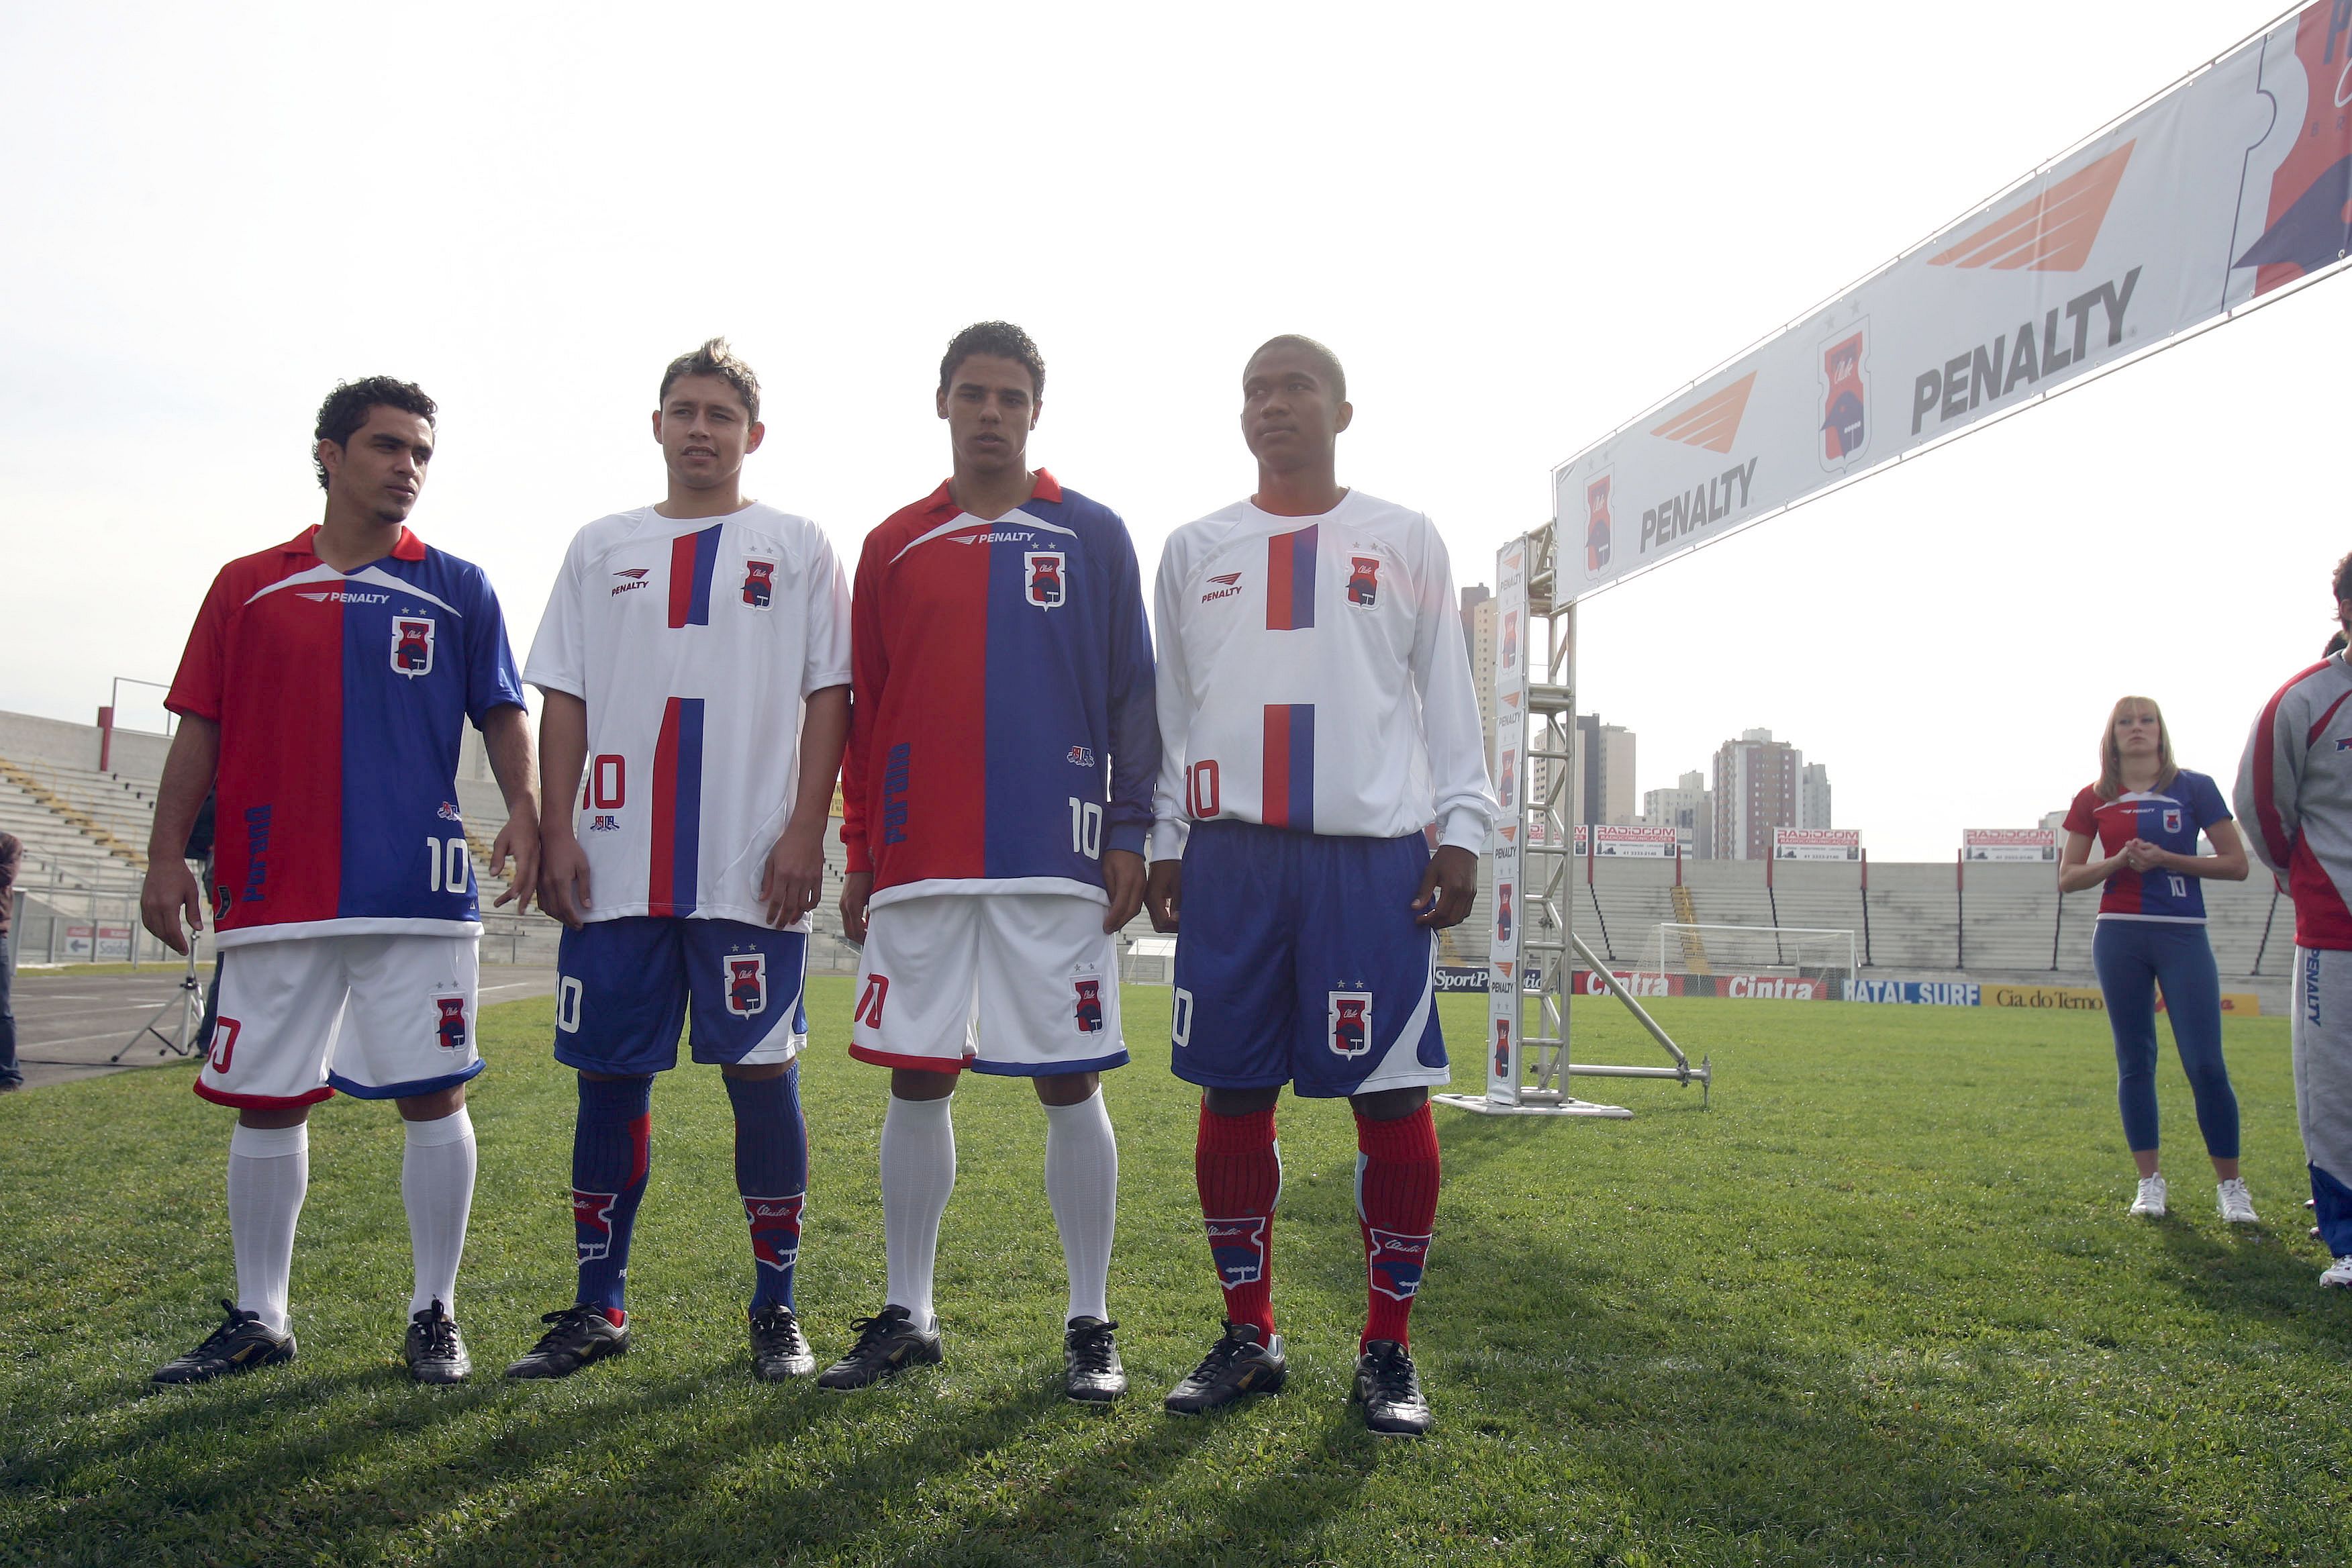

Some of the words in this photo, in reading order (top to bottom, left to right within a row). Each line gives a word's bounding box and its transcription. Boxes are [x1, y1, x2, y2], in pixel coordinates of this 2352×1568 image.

[1912, 265, 2143, 436] PENALTY
[1640, 456, 1758, 553] PENALTY
[978, 532, 1035, 544] PENALTY
[611, 581, 649, 597] PENALTY
[1500, 573, 1523, 593] PENALTY
[330, 591, 390, 603] PENALTY
[1202, 586, 1242, 604] PENALTY
[1499, 712, 1522, 727] PENALTY
[1069, 797, 1103, 860] 10
[1495, 846, 1517, 859] PENALTY
[427, 837, 469, 893] 10
[2167, 875, 2186, 897] 10
[1491, 982, 1514, 993] PENALTY
[1729, 977, 1812, 999] Cintra
[1919, 983, 1979, 1006] SURF
[556, 972, 583, 1034] 0
[2030, 990, 2053, 1008] do
[2055, 991, 2103, 1010] Terno
[1173, 987, 1193, 1047] 0
